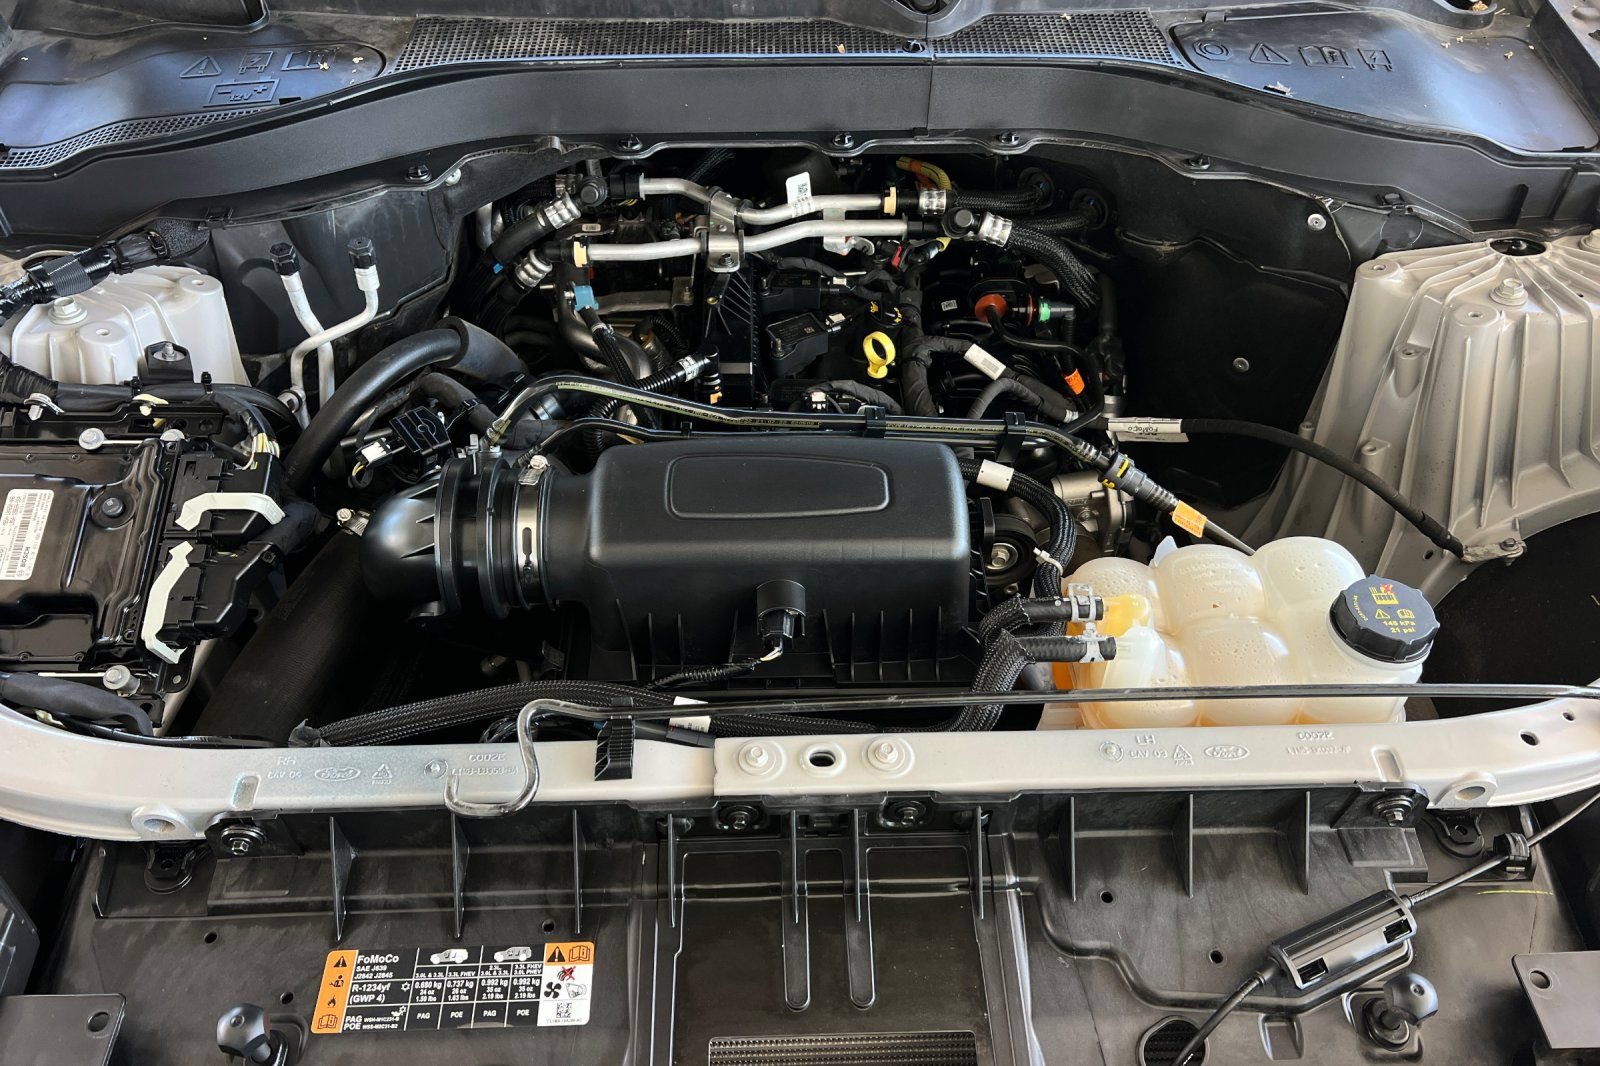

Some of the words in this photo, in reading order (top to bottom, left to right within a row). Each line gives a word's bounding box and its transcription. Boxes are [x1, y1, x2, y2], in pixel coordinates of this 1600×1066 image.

[20, 546, 30, 568] BOSCH
[1136, 735, 1155, 746] LH
[356, 954, 400, 964] FoMoCo
[433, 981, 442, 989] kg
[465, 980, 474, 989] kg
[500, 979, 508, 987] kg
[532, 978, 540, 986] kg
[352, 983, 391, 992] R-1234yf
[350, 994, 375, 1004] (GWP
[376, 993, 386, 1004] 4)
